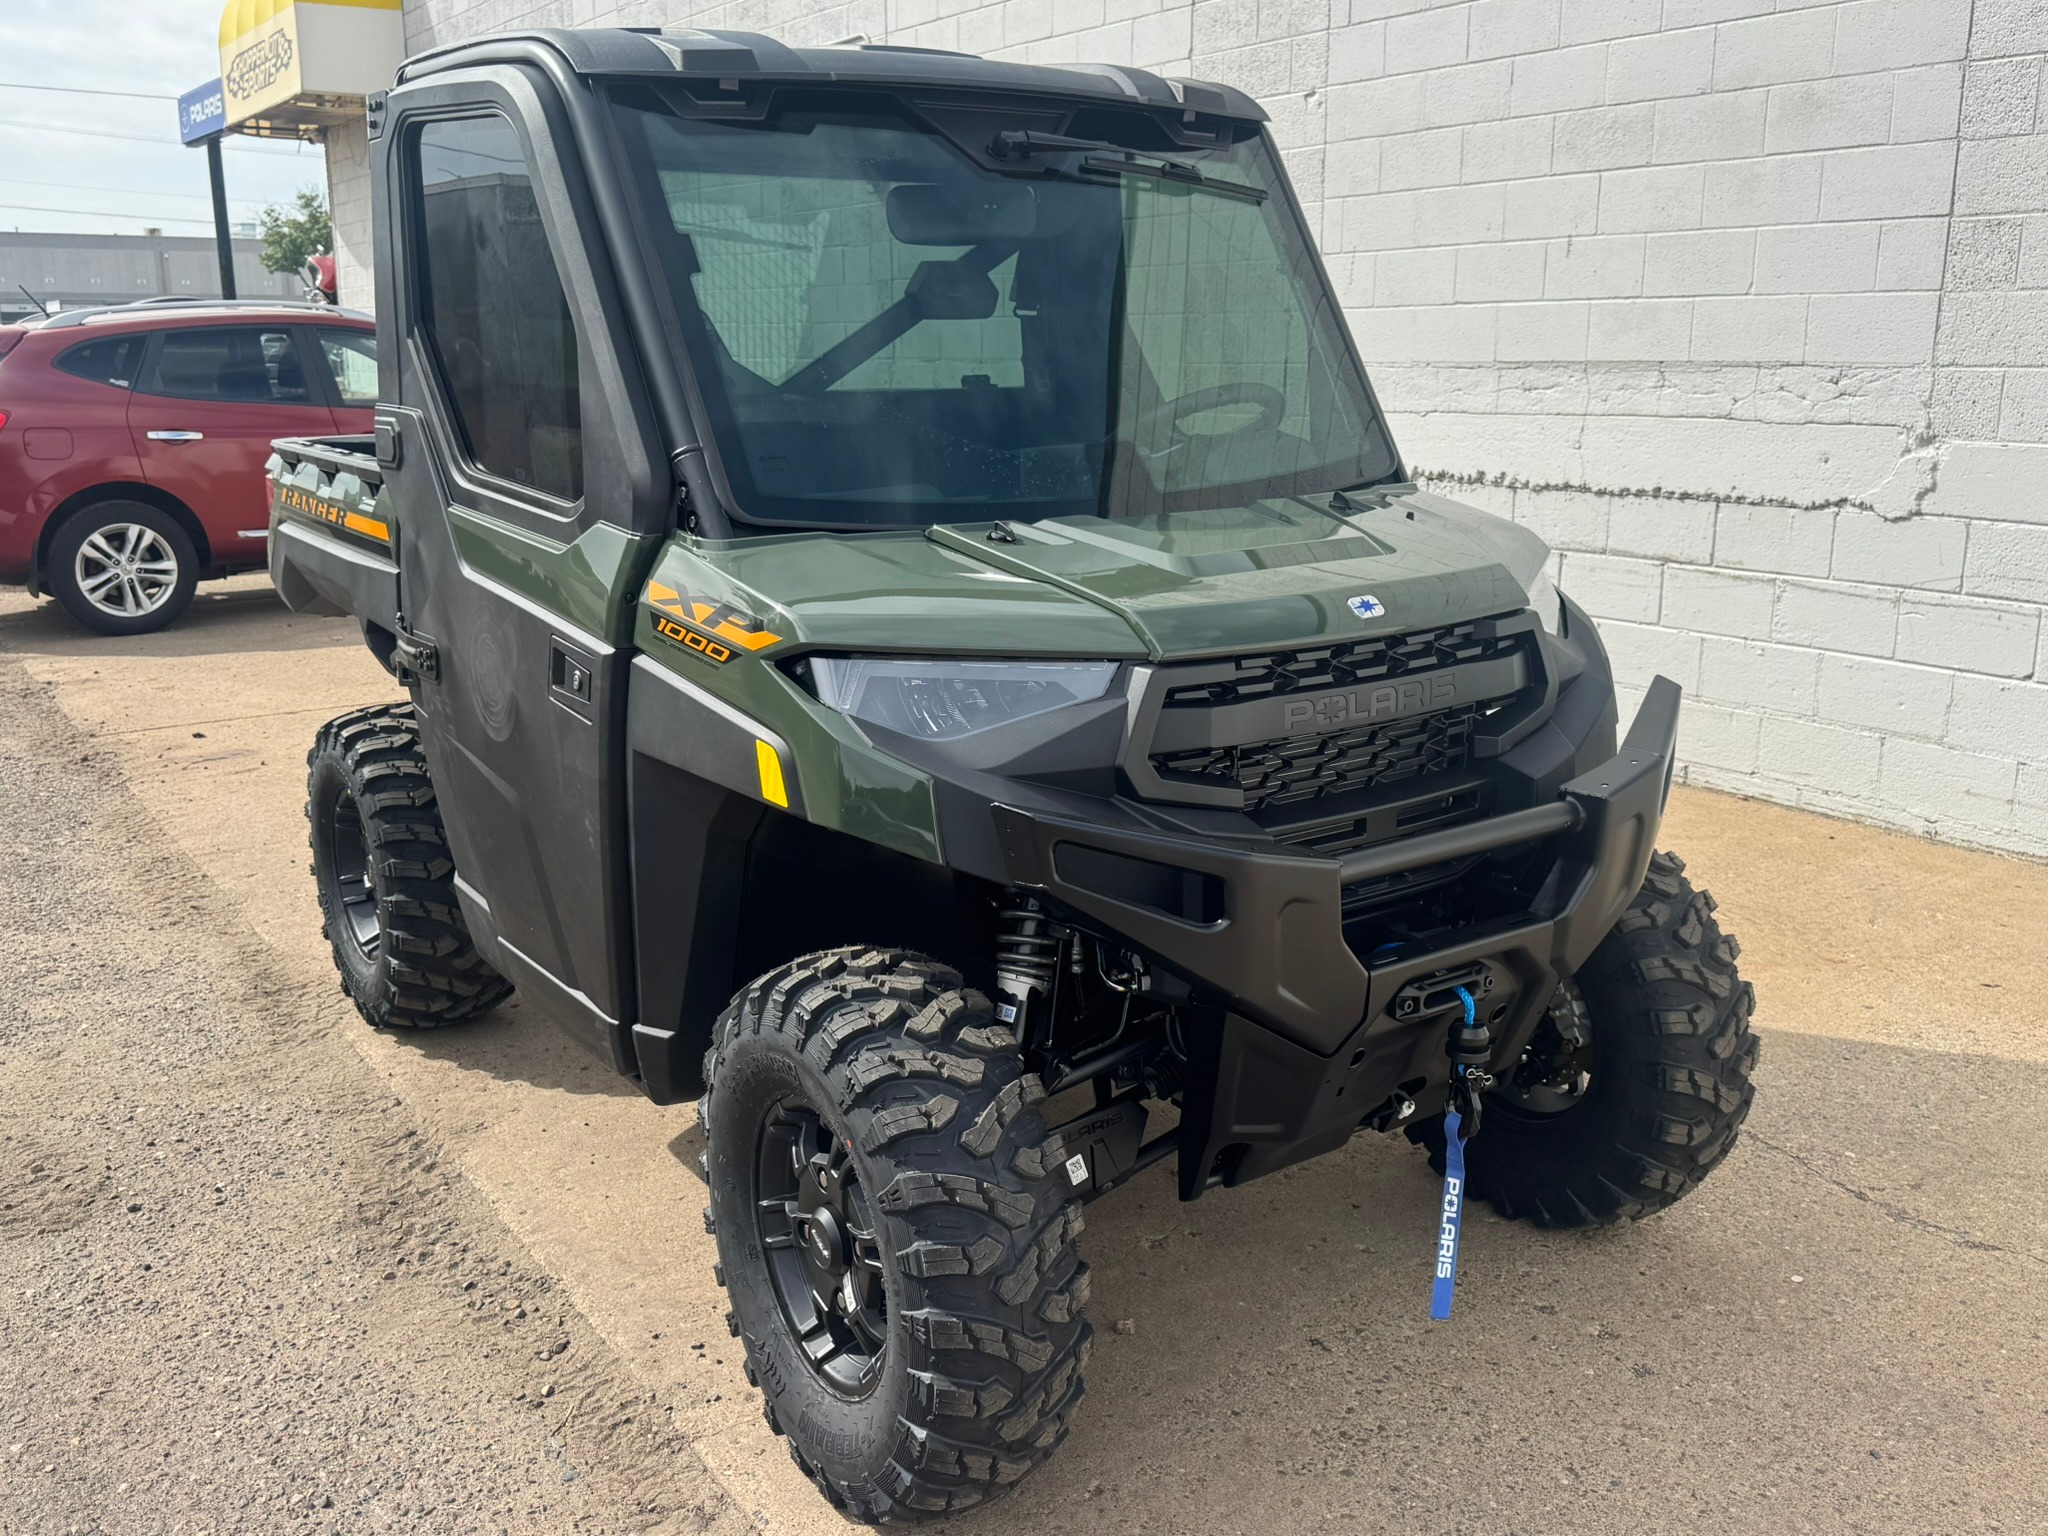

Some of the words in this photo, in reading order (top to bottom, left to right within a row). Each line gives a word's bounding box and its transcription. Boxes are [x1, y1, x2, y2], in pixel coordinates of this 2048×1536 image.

[240, 57, 277, 100] SPORTS
[190, 92, 223, 125] POLARIS
[281, 487, 347, 526] RANGER
[652, 580, 765, 634] XP
[657, 618, 731, 662] 1000
[1284, 672, 1457, 730] POLARIS
[1064, 1111, 1124, 1144] LARIS
[1437, 1177, 1461, 1279] POLARIS
